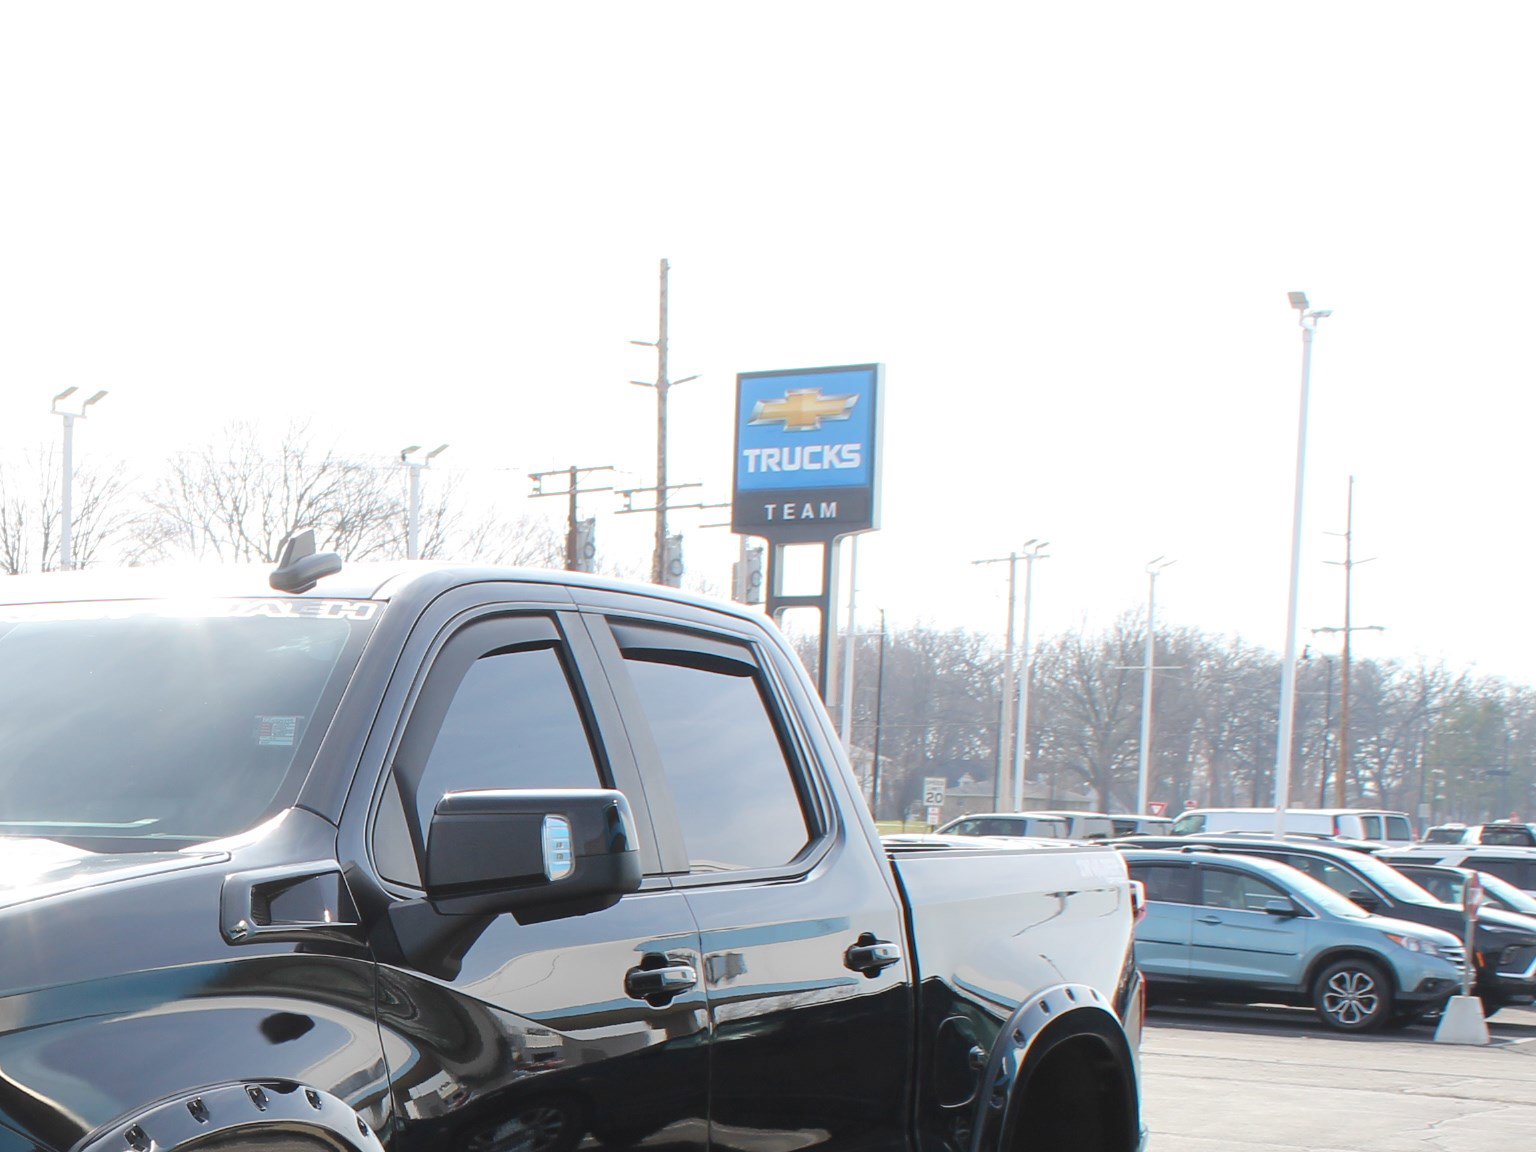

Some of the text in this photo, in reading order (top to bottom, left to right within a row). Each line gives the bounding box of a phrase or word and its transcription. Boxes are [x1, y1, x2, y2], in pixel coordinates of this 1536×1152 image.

[743, 443, 862, 473] TRUCKS
[765, 502, 838, 520] TEAM
[926, 792, 943, 804] 20
